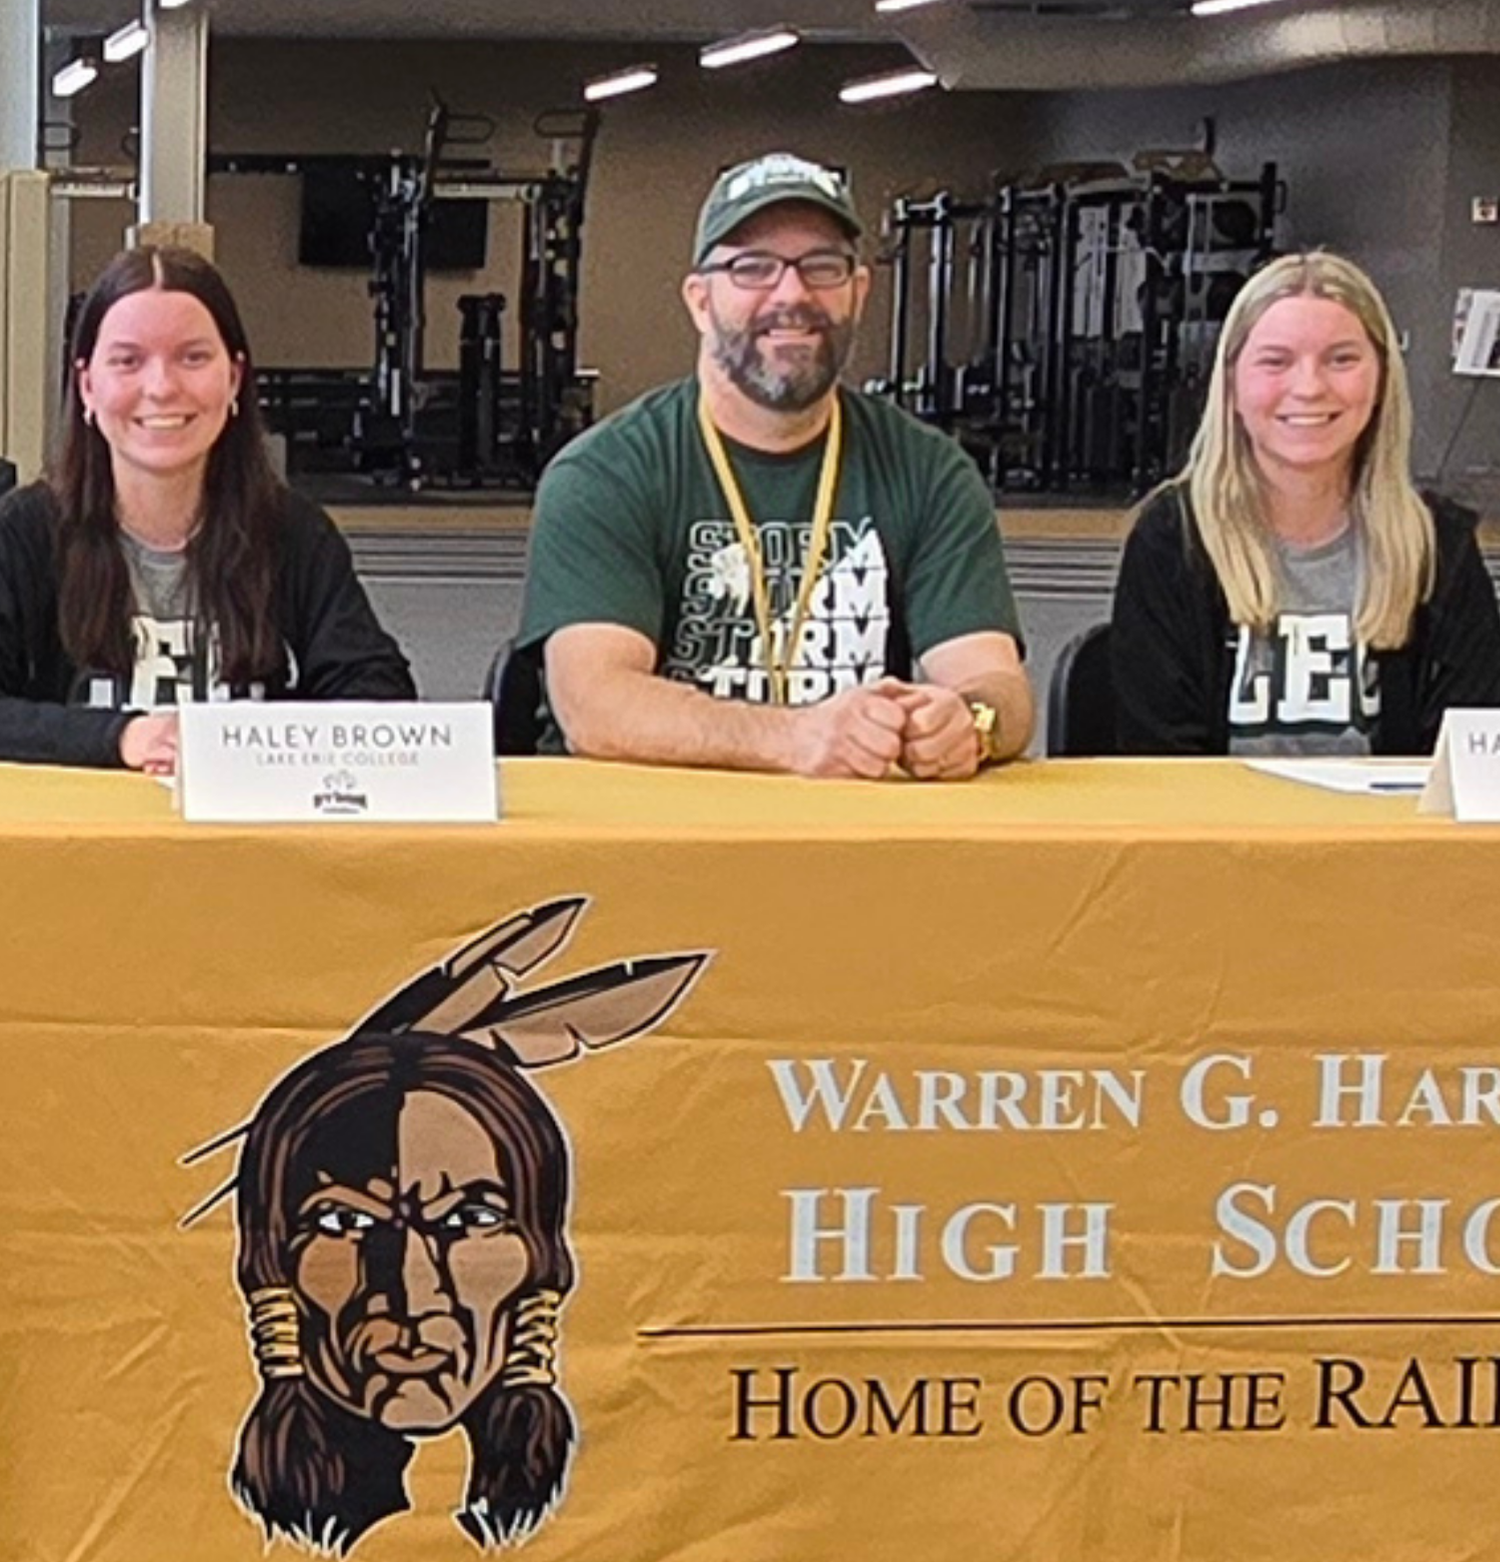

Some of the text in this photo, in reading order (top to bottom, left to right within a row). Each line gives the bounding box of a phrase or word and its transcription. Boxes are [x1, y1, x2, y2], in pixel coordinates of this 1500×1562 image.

[221, 723, 452, 749] HALEY BROWN
[256, 752, 295, 766] LAKE
[342, 752, 419, 766] COLLEGE
[766, 1058, 1145, 1132] WARREN
[1180, 1054, 1279, 1130] G.
[781, 1187, 1113, 1282] HIGH
[729, 1367, 983, 1441] HOME
[1009, 1376, 1109, 1436] OF
[1134, 1372, 1286, 1434] THE
